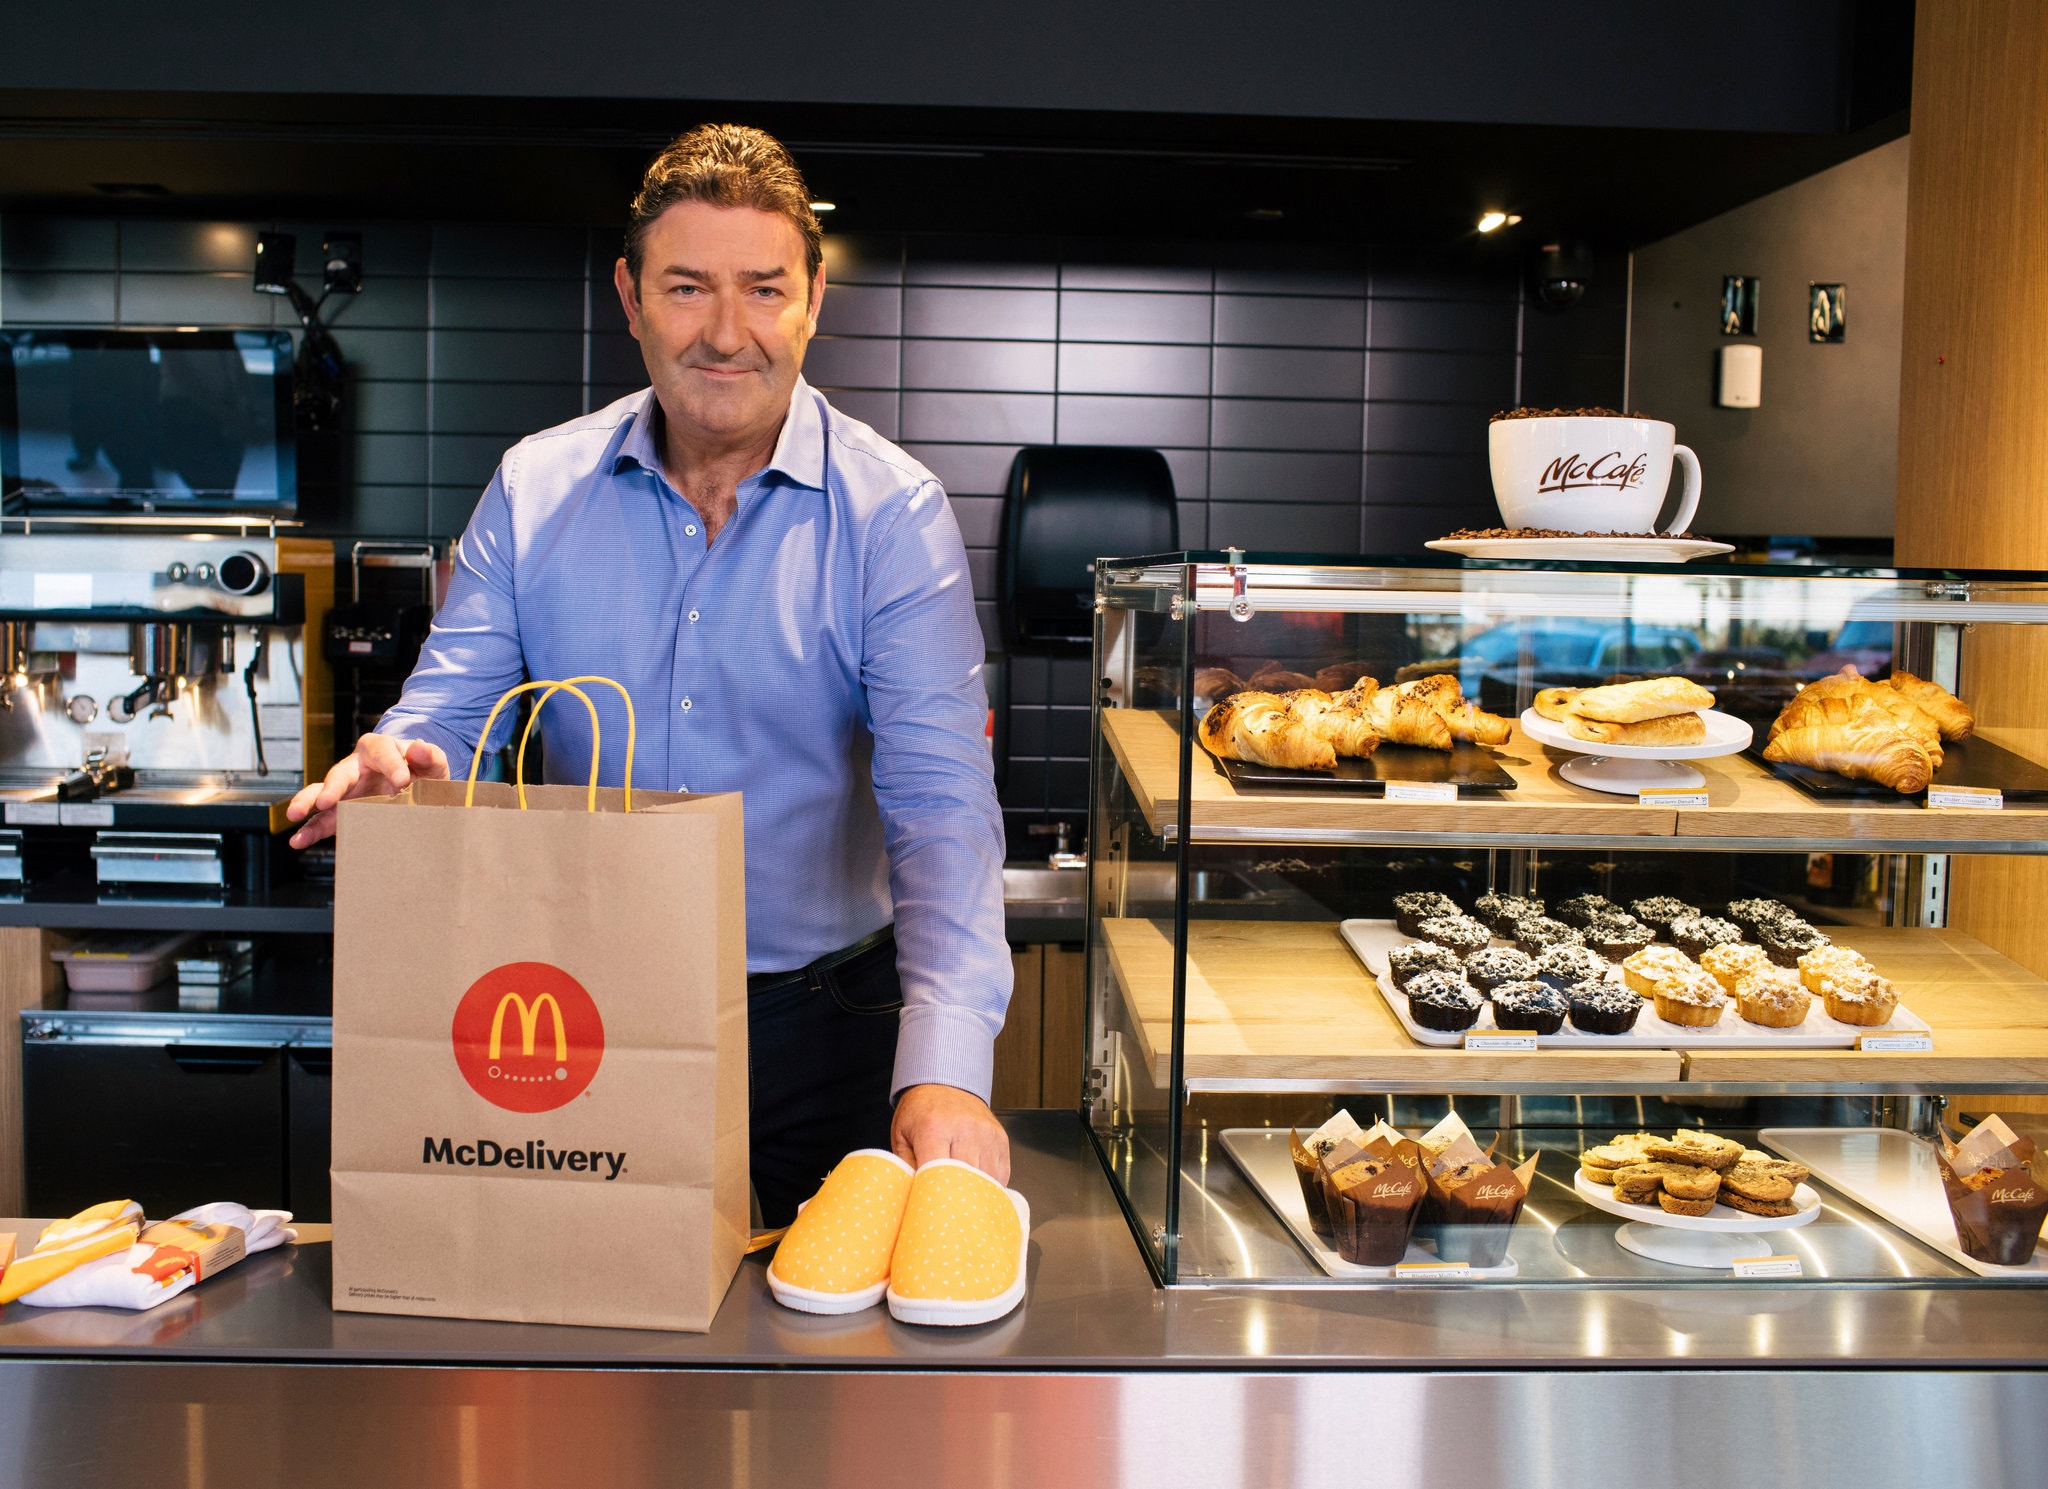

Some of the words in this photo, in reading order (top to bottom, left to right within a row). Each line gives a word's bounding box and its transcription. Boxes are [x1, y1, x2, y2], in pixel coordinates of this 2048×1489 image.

[1538, 451, 1647, 493] McCafé
[422, 1136, 627, 1181] McDelivery
[1372, 1181, 1413, 1198] McCafé
[1475, 1184, 1516, 1200] McCafé
[1991, 1187, 2035, 1204] McCafé
